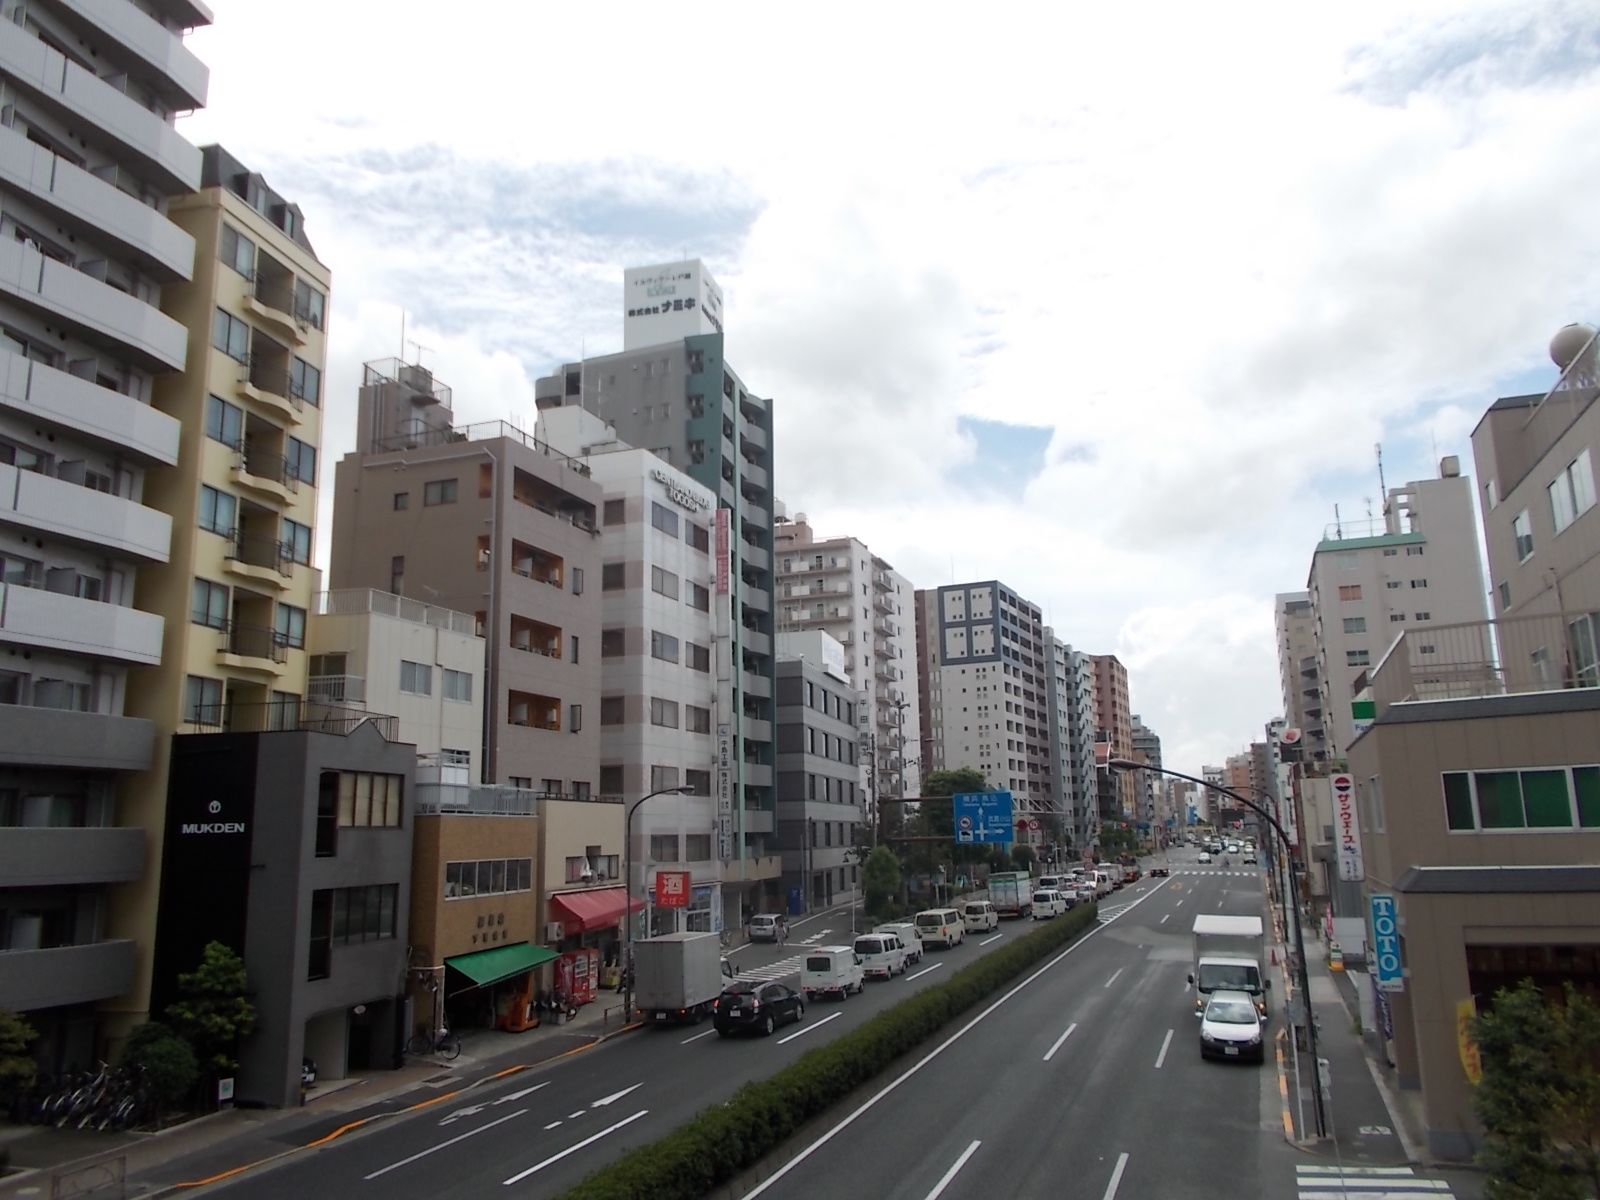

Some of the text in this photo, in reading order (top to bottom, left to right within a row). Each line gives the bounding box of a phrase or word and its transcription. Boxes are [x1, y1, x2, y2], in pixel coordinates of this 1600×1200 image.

[182, 822, 245, 834] MUKDEN
[662, 873, 684, 895] 酒
[1373, 898, 1398, 972] TOTO
